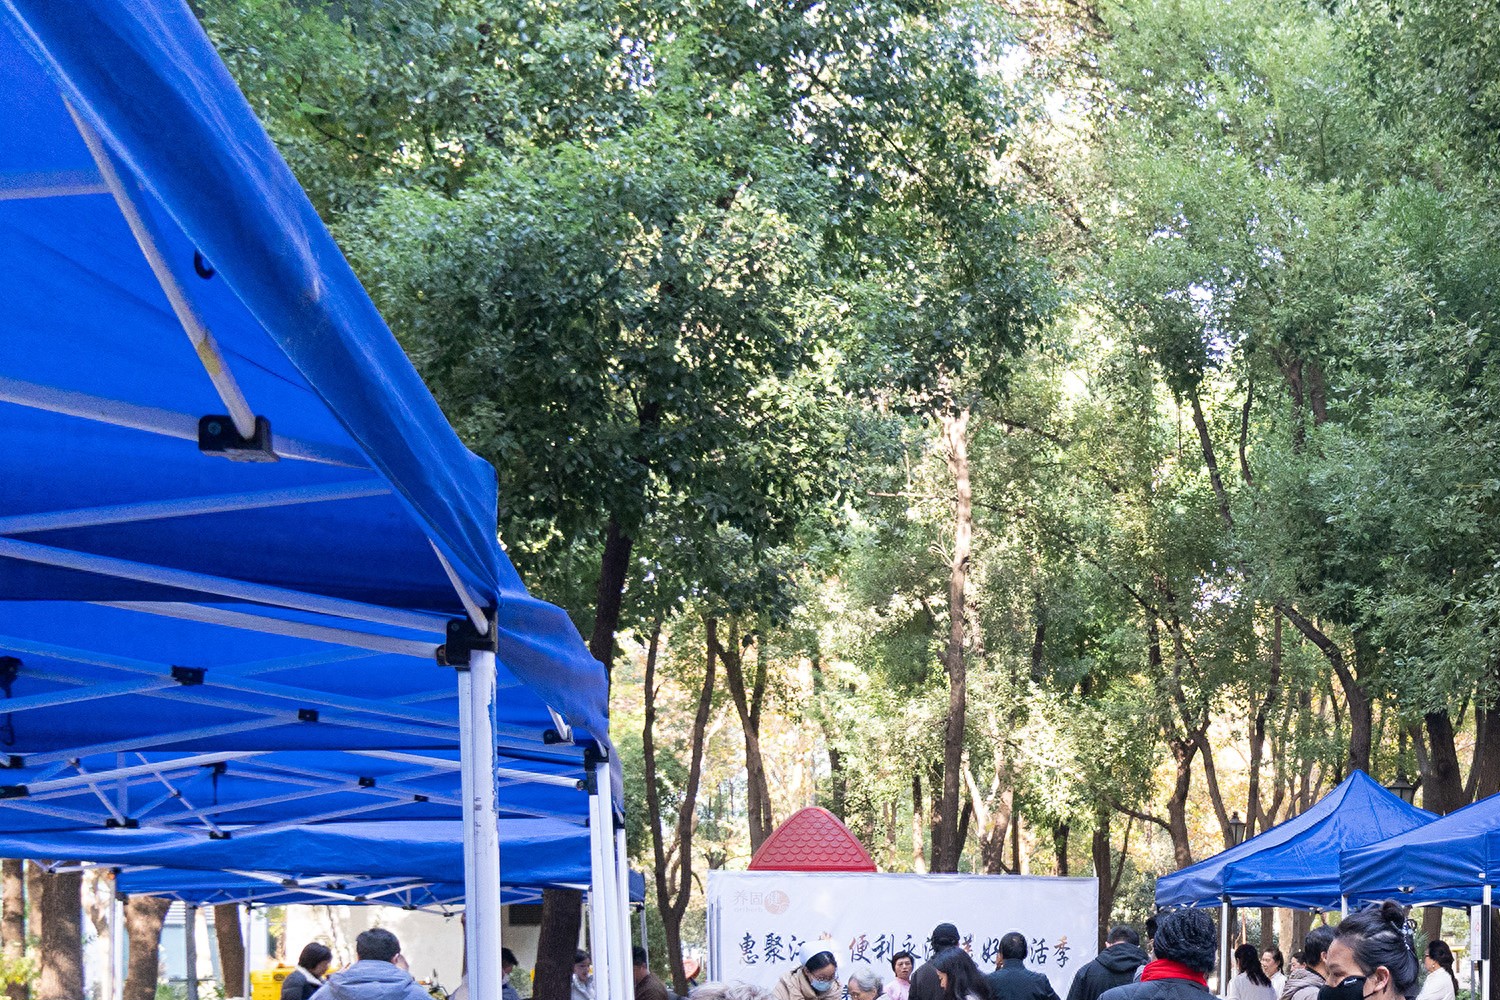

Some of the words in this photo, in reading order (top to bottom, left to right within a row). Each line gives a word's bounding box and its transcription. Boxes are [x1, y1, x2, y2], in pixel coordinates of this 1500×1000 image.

[739, 931, 832, 964] 惠聚江
[962, 934, 1071, 967] 美好活季
